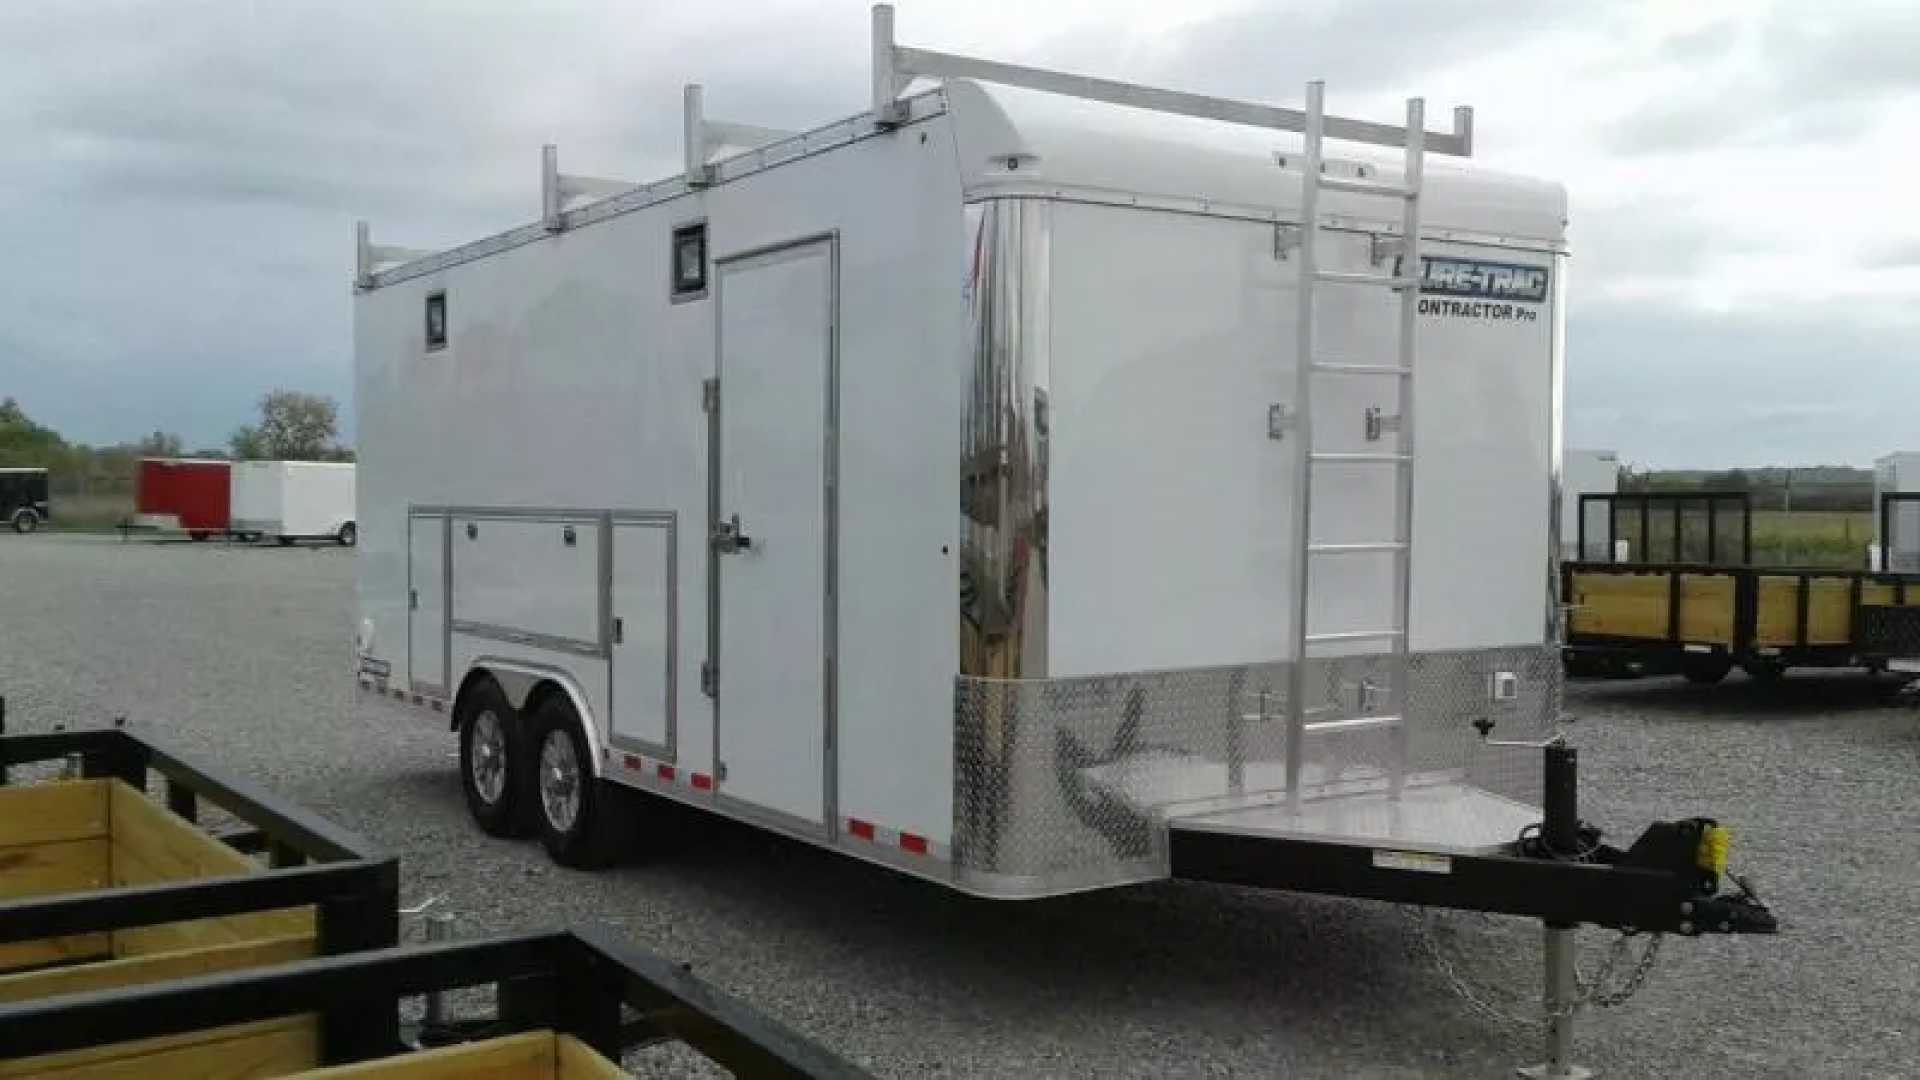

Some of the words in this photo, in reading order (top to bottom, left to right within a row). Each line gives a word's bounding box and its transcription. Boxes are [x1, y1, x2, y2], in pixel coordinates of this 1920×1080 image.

[1412, 260, 1546, 297] URE-TRAC
[1417, 299, 1513, 320] ONTRACTOR
[1516, 306, 1537, 322] Pro
